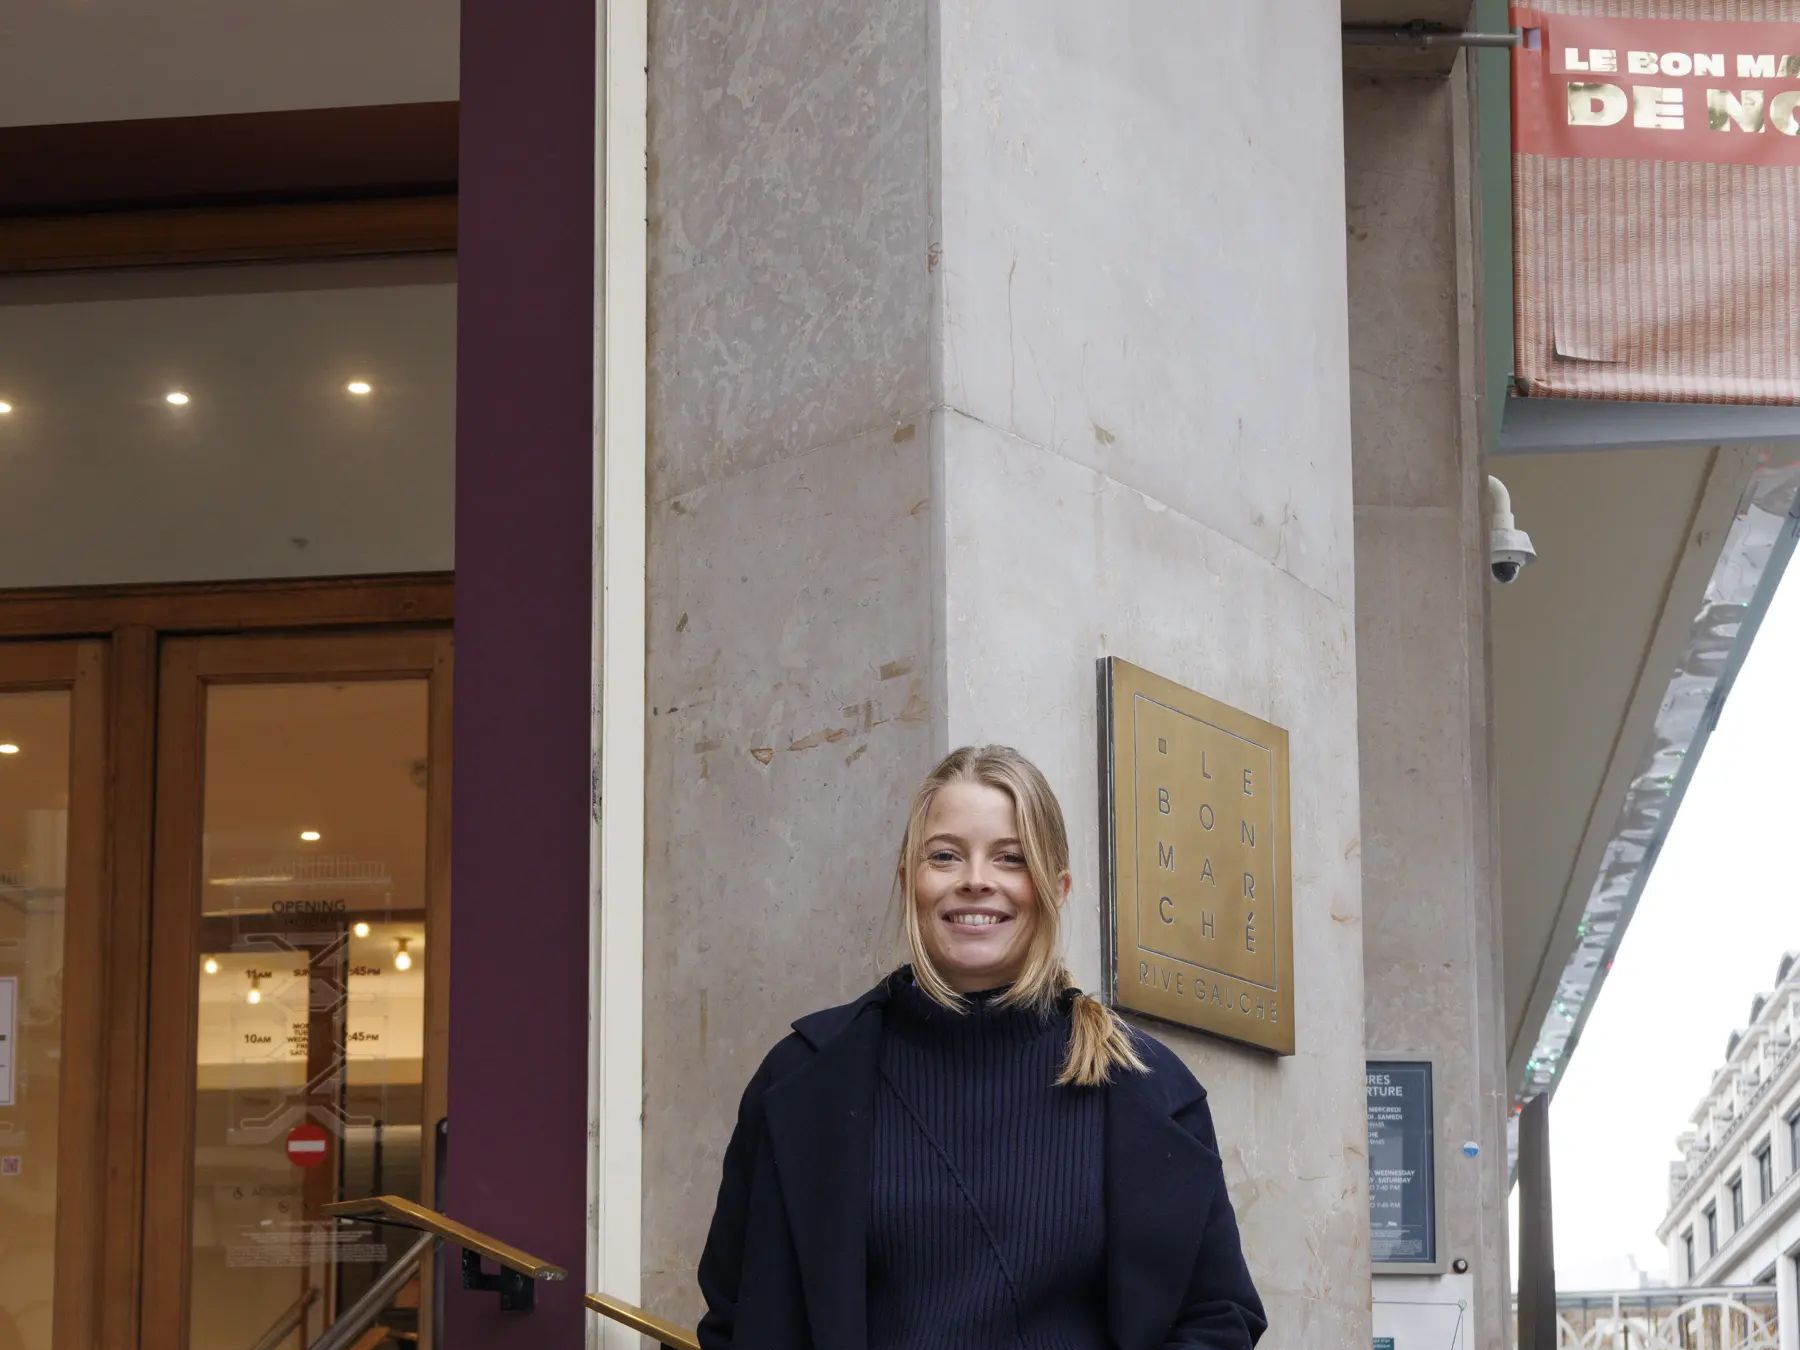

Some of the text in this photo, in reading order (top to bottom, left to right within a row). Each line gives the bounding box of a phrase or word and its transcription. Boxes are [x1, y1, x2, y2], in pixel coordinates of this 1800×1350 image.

[1565, 48, 1618, 72] LE
[1627, 51, 1725, 77] BON
[1567, 81, 1685, 130] DE
[272, 899, 346, 914] OPENING
[1139, 961, 1277, 1024] RIVE GAUCHE
